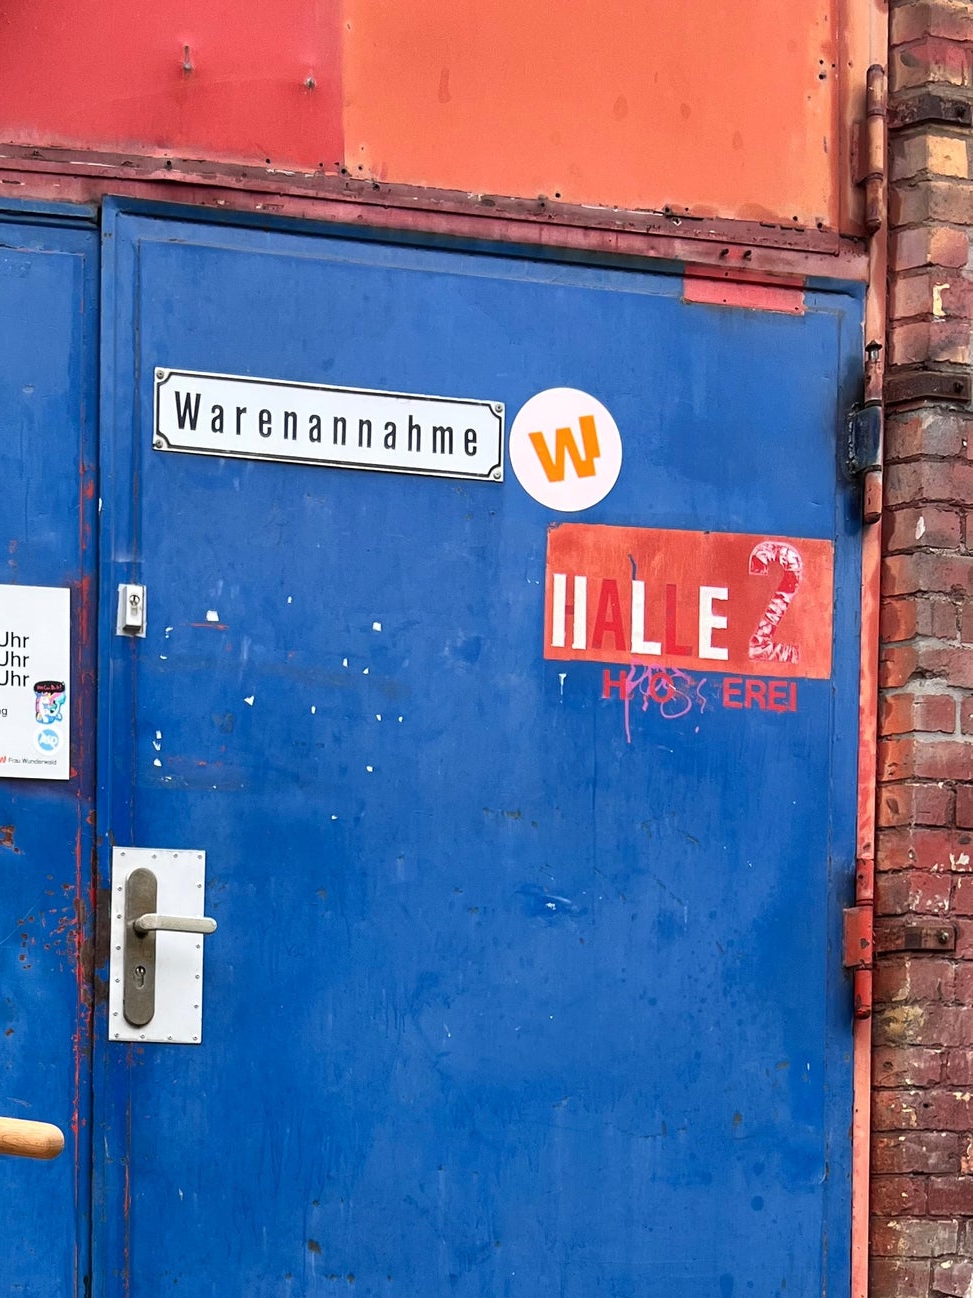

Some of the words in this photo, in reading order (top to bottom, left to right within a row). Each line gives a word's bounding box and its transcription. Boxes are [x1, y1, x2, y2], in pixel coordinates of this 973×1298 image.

[174, 390, 478, 457] Warenannahme
[551, 573, 729, 660] HALLE
[748, 541, 803, 664] 2
